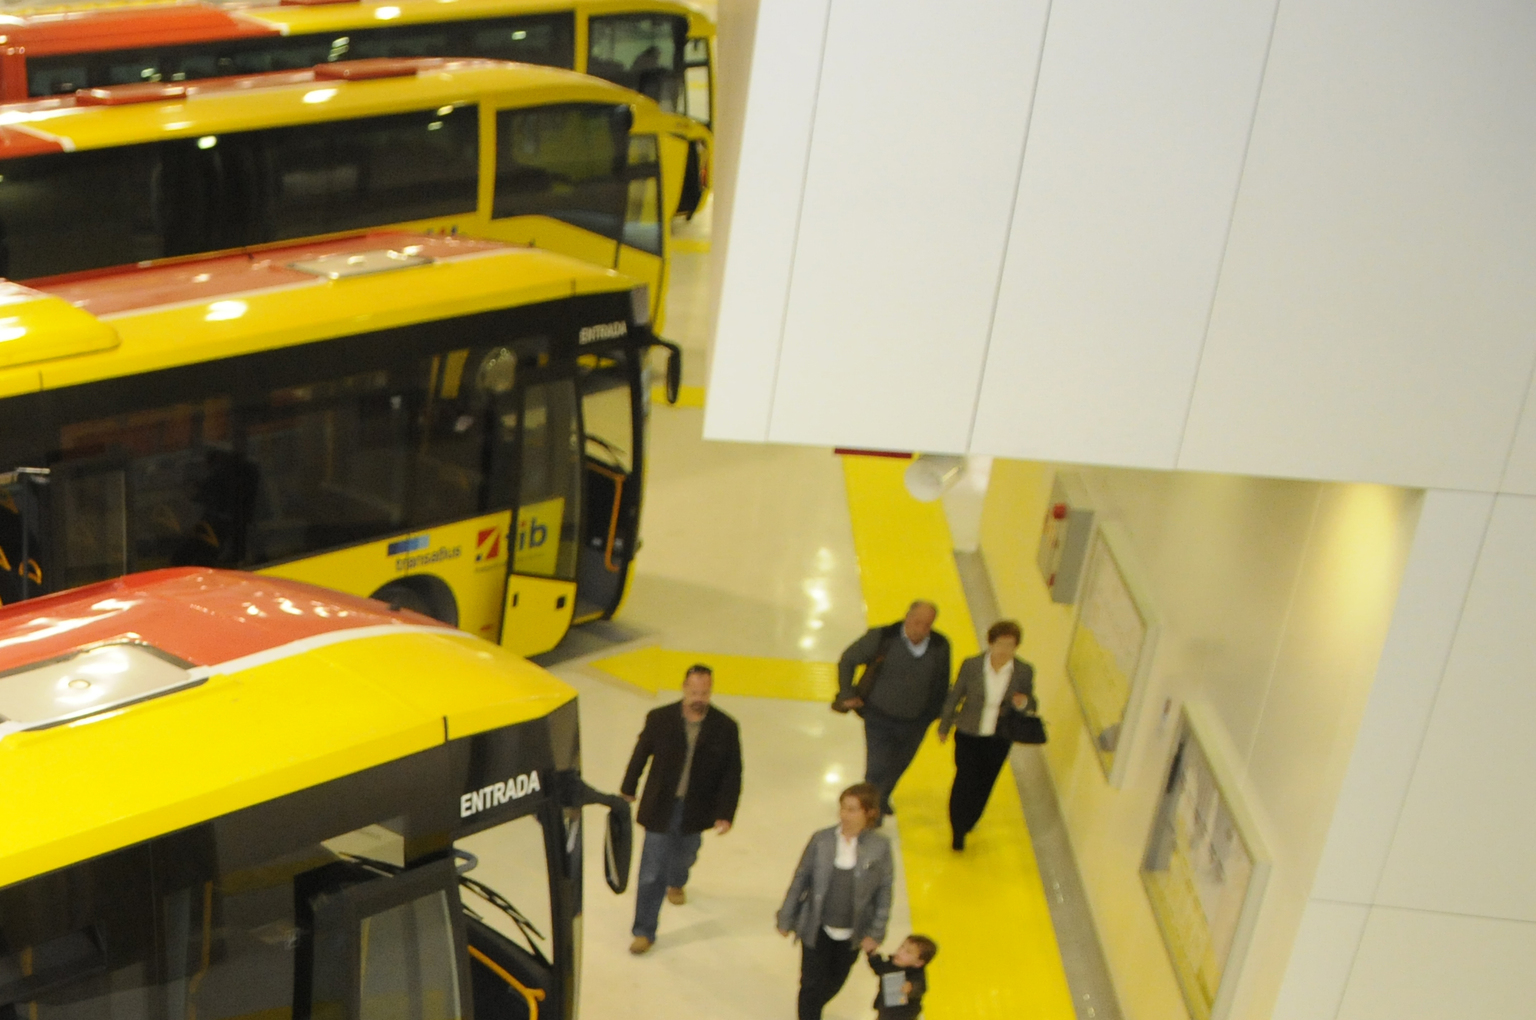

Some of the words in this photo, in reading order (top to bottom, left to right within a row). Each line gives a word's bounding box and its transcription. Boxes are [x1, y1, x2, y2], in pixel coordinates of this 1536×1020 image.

[579, 320, 627, 345] ENTRADA
[507, 517, 547, 551] ib
[395, 546, 462, 571] transaBus
[460, 769, 541, 818] ENTRADA
